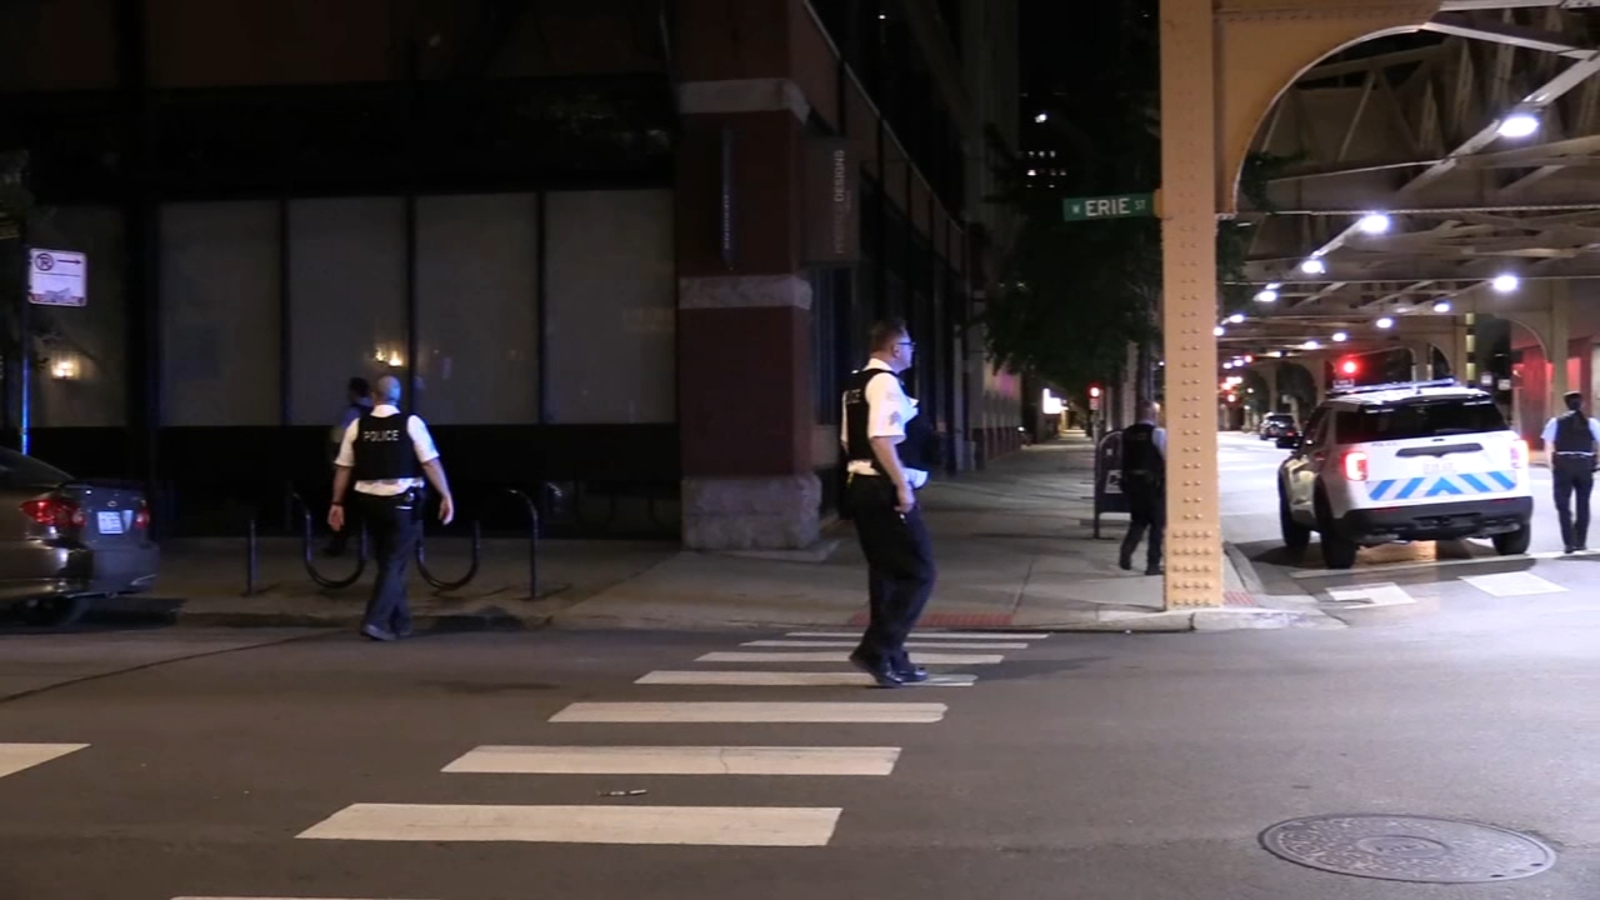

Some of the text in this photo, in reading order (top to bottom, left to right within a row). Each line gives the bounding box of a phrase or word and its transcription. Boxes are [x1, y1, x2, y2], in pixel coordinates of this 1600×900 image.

[833, 149, 846, 202] DESIGNS
[1085, 198, 1131, 217] ERIE
[1134, 200, 1146, 210] ST
[363, 429, 400, 442] POLICE
